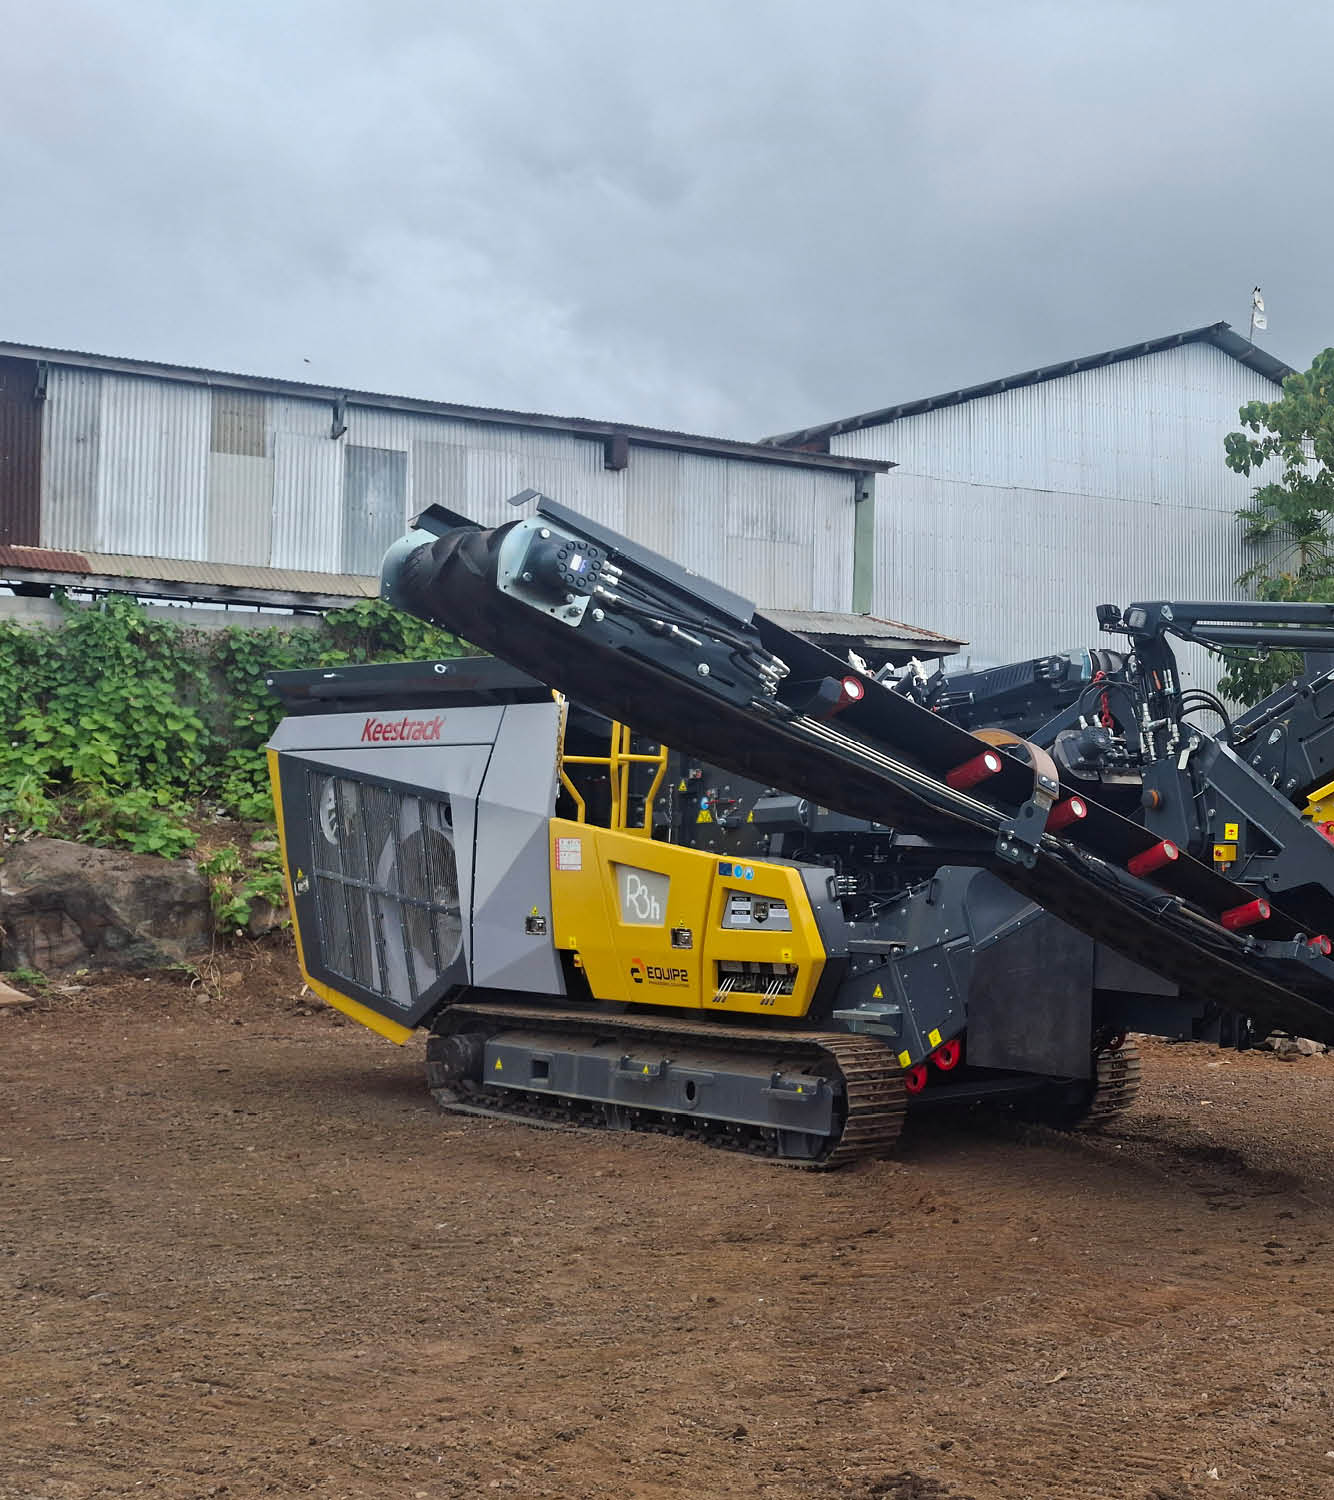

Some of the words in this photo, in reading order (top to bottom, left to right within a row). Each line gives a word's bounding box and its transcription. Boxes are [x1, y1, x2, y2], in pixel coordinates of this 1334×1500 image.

[361, 716, 444, 742] Keestrack
[626, 874, 660, 920] R3h
[647, 966, 689, 982] EQUIP2
